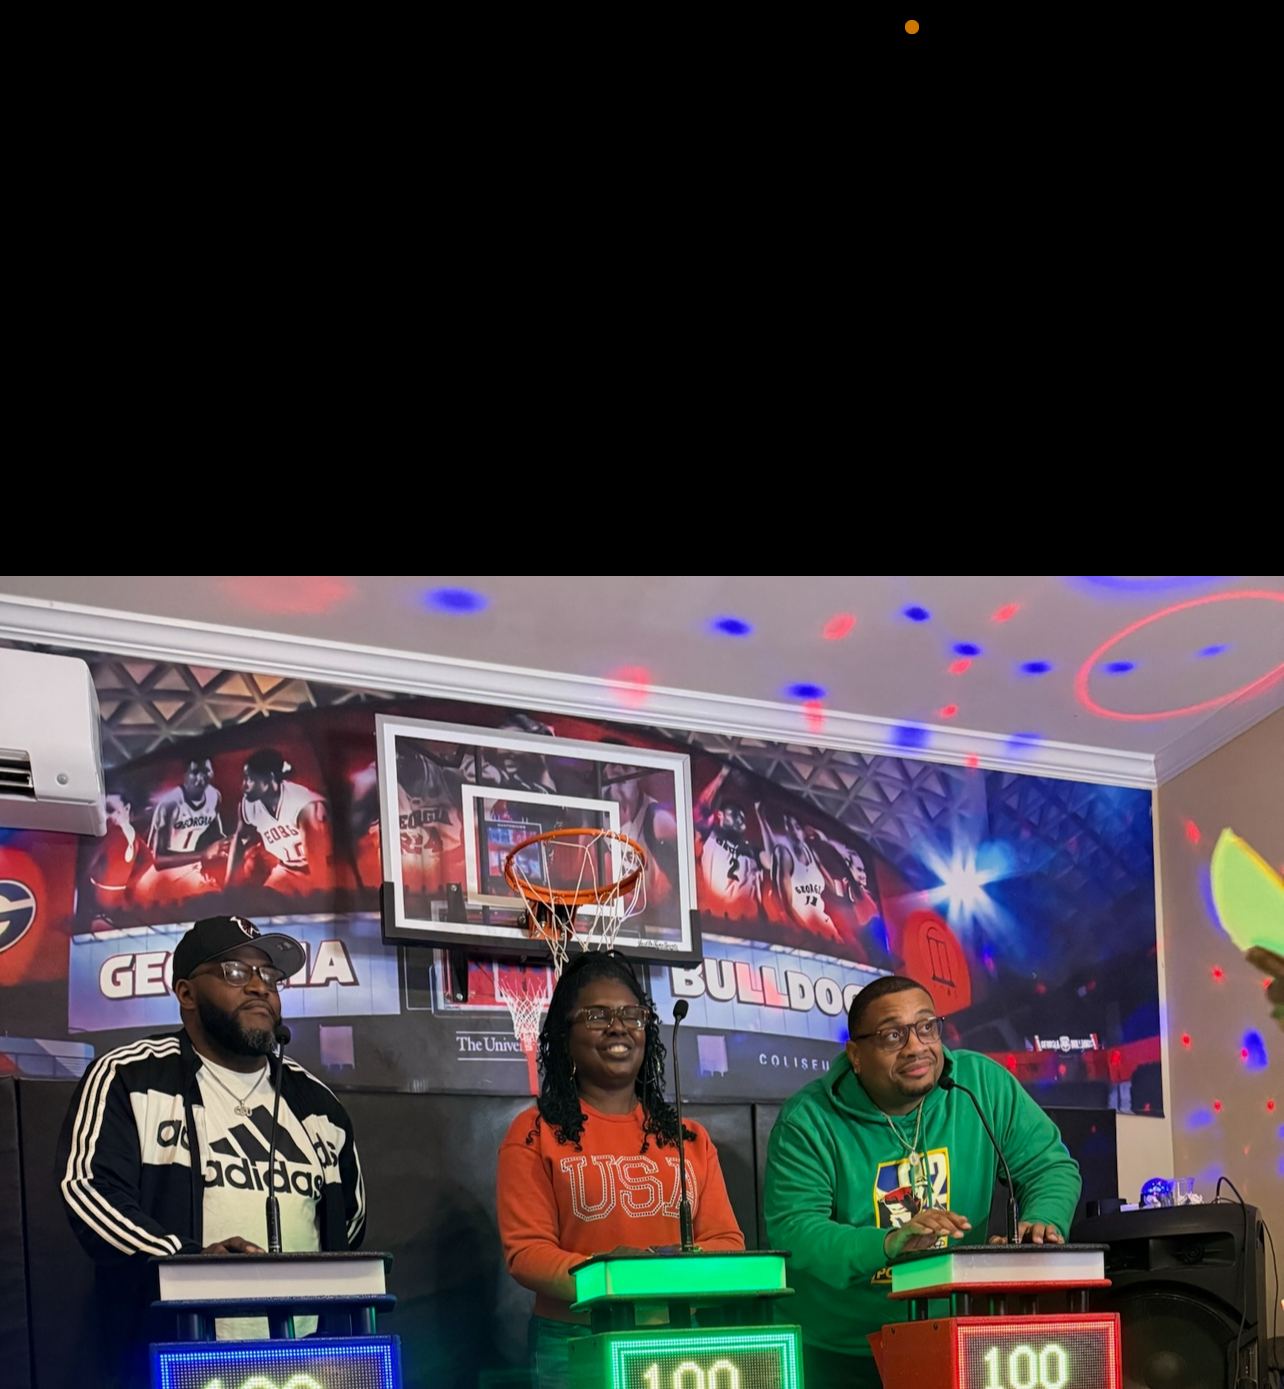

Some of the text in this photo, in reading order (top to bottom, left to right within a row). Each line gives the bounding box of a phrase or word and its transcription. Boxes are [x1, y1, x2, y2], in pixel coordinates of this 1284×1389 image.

[727, 858, 740, 882] 2
[456, 1036, 482, 1051] The
[204, 1157, 324, 1200] adidas
[560, 1154, 697, 1222] USA
